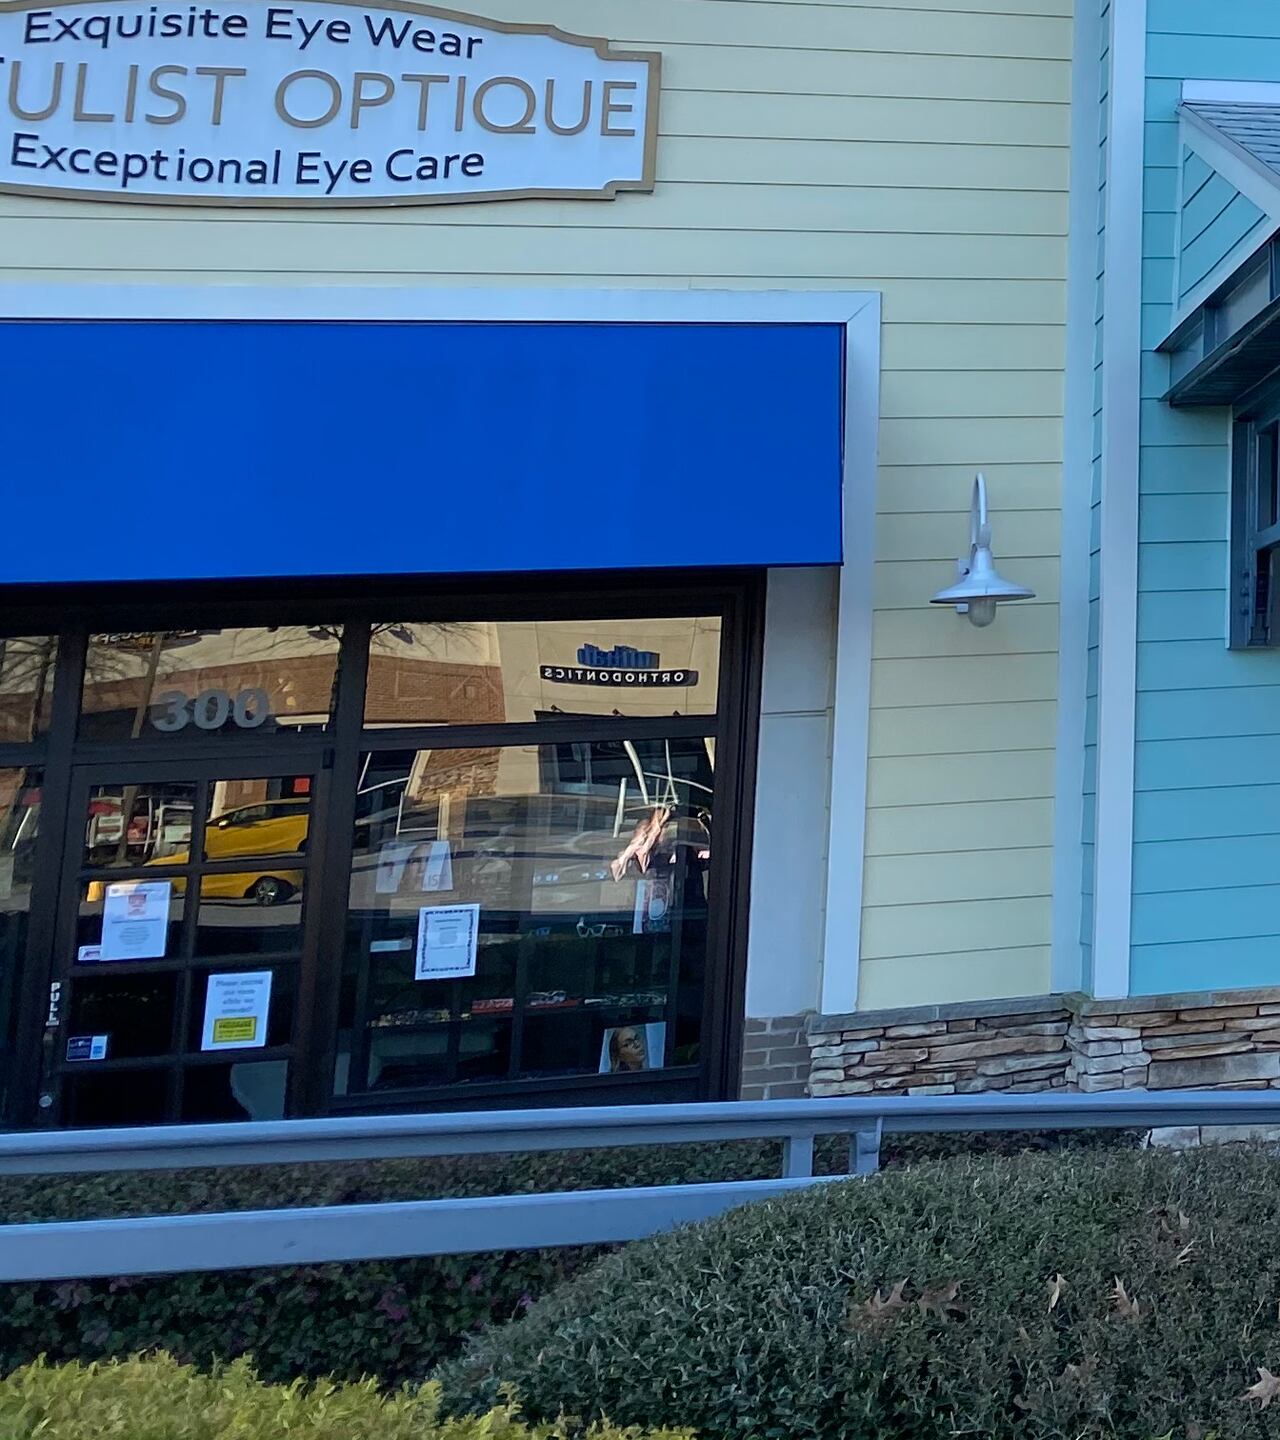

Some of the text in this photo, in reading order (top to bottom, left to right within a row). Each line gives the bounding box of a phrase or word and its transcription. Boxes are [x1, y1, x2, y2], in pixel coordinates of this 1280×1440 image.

[23, 6, 484, 58] Exquisite Eye Wear
[2, 60, 638, 137] ULIST OPTIQUE
[10, 131, 485, 194] Exceptional Eye Care
[151, 687, 270, 732] 300
[48, 982, 61, 1021] PULL
